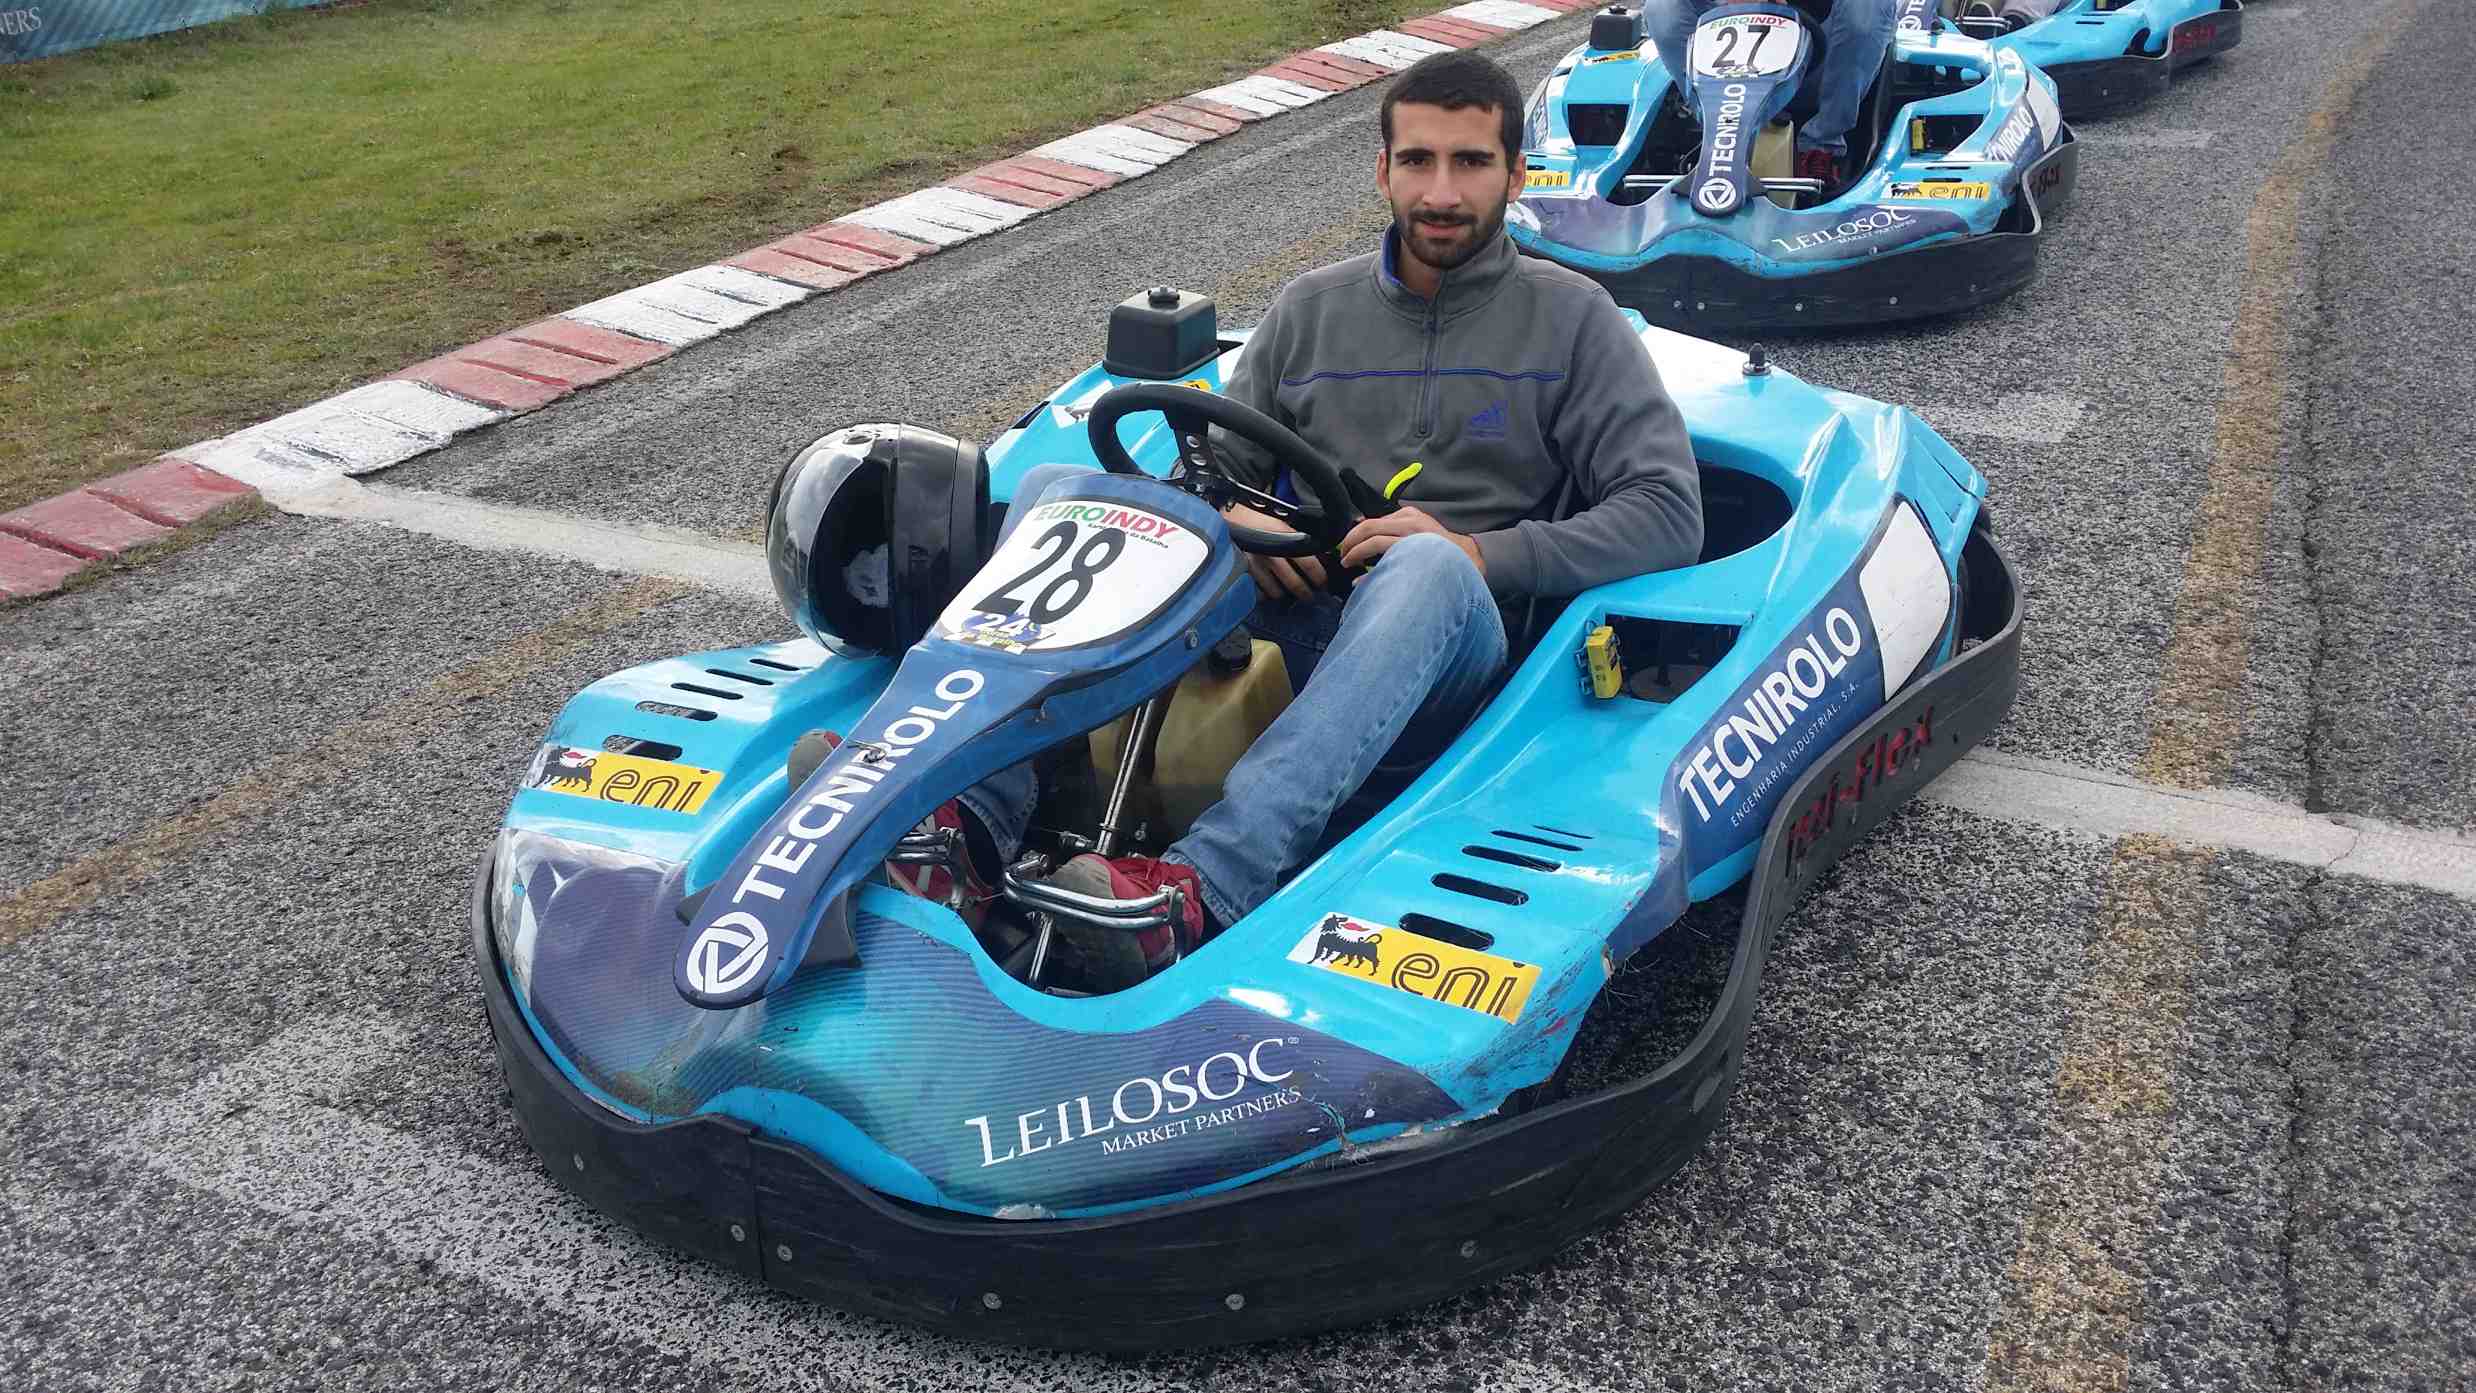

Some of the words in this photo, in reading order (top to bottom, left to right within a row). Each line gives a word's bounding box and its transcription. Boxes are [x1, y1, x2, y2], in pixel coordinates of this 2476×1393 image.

[1710, 16, 1786, 29] EUROINDY
[1712, 25, 1771, 71] 27
[1709, 83, 1747, 177] TECNIROLO
[1928, 181, 1986, 200] eni
[1772, 208, 1912, 252] LEILOSOC
[1034, 504, 1179, 539] EUROINDY
[971, 520, 1126, 625] 28
[1679, 607, 1861, 823] TECNIROLO
[600, 769, 710, 813] eni
[732, 668, 985, 904] TECNIROLO
[1730, 760, 1787, 827] ENGENHARIA
[1391, 952, 1526, 1017] eni
[1101, 1118, 1191, 1155] MARKET
[1195, 1085, 1303, 1131] PARTNERS
